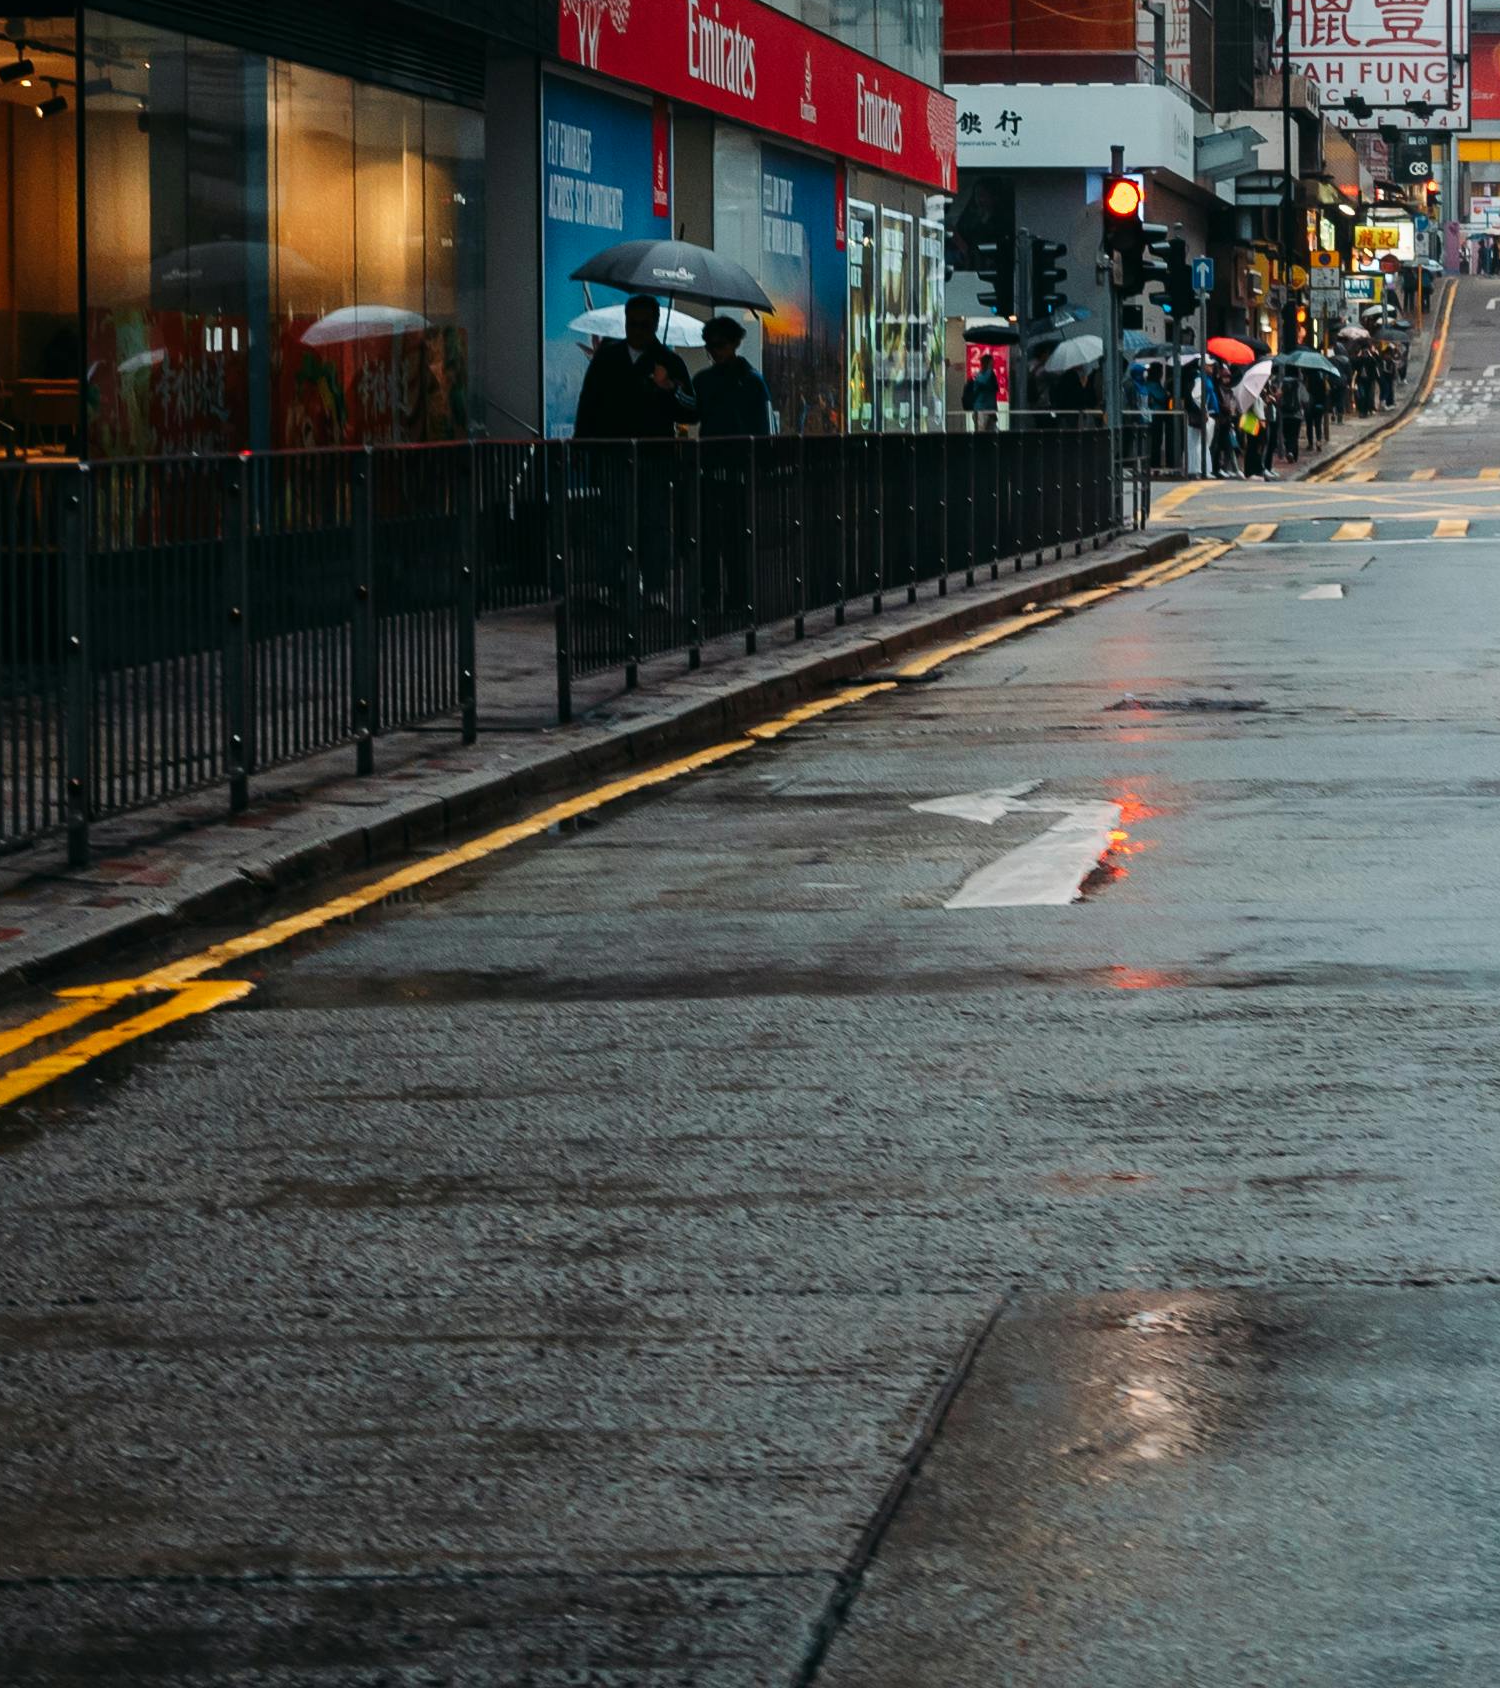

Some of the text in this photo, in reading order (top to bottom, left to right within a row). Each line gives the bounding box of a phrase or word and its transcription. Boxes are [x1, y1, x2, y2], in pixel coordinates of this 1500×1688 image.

[1360, 62, 1448, 84] FUNG
[856, 72, 903, 155] Emirates
[956, 110, 1023, 137] 銀行
